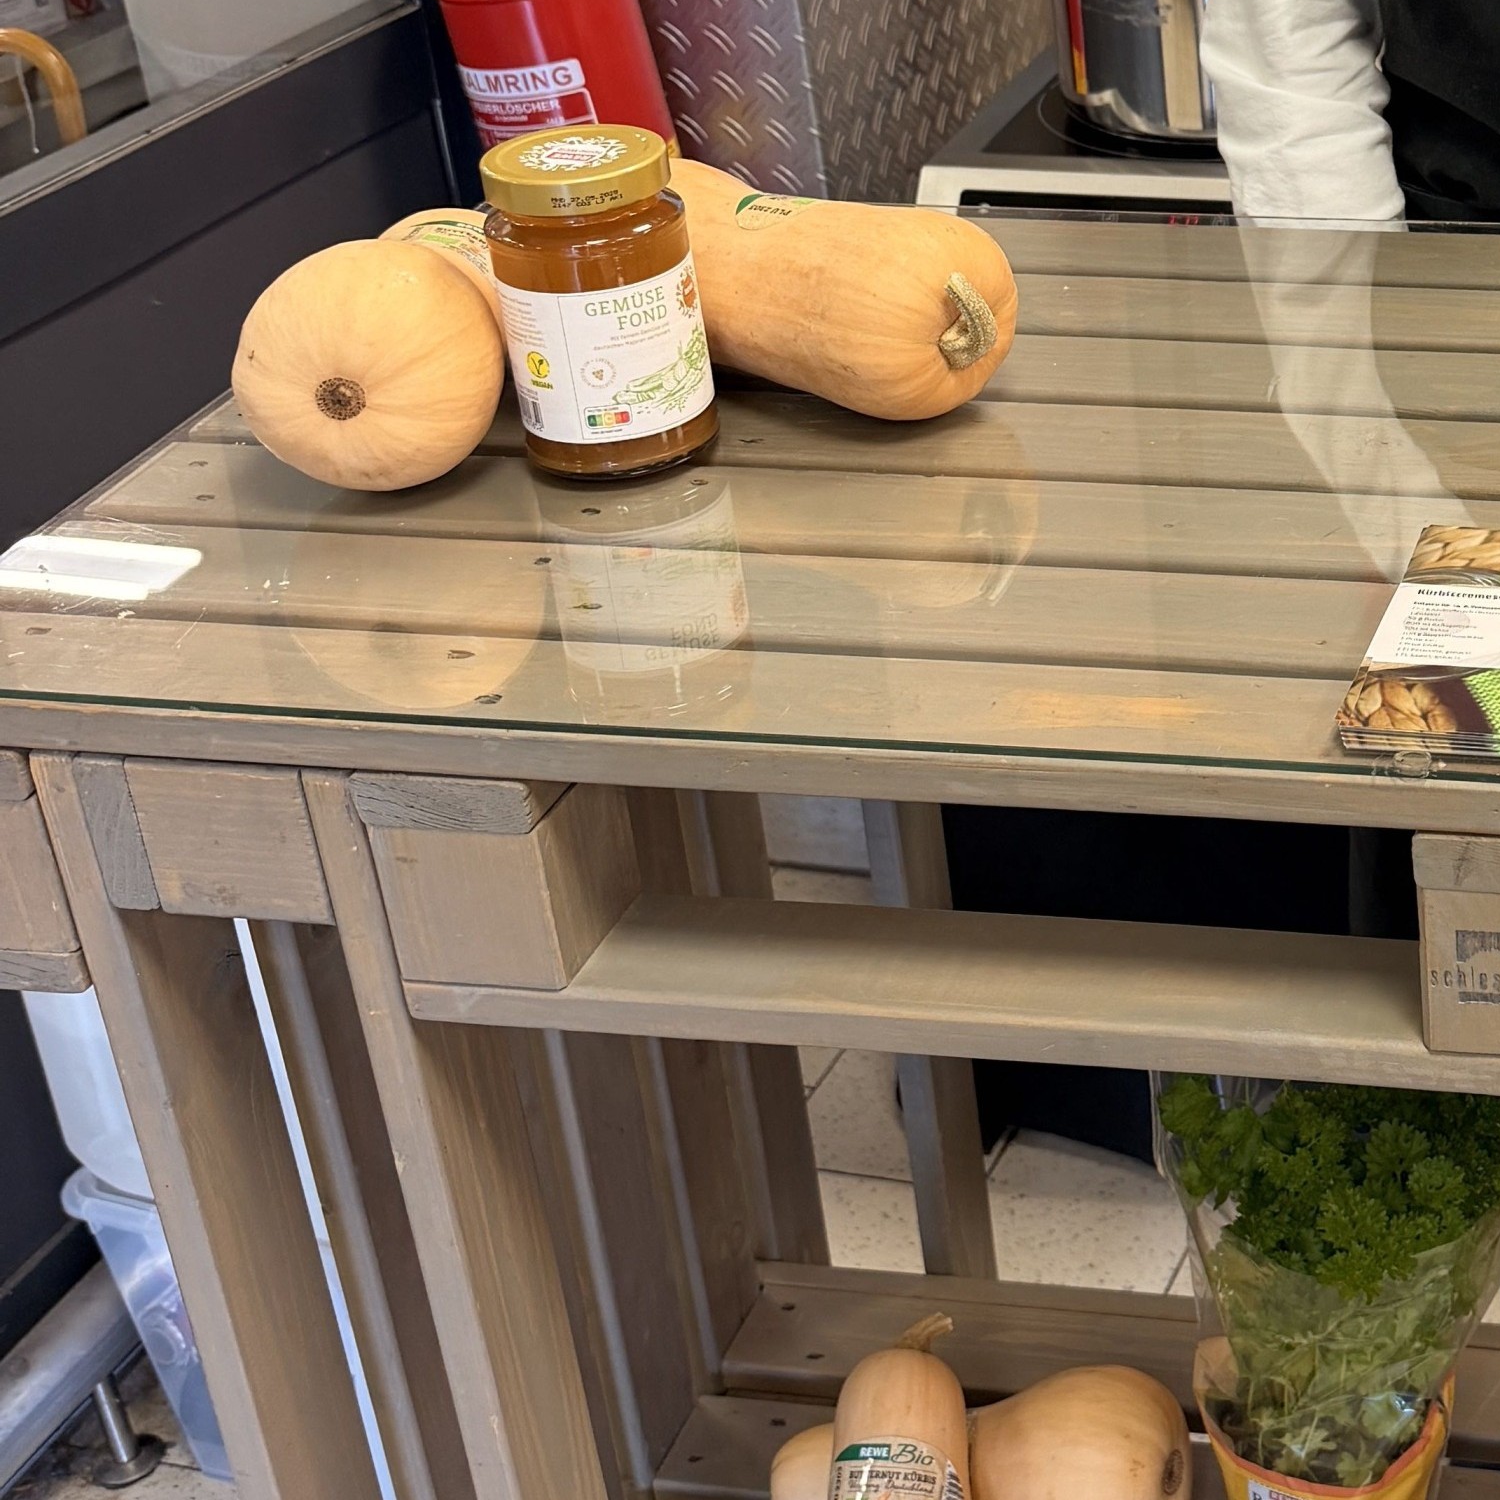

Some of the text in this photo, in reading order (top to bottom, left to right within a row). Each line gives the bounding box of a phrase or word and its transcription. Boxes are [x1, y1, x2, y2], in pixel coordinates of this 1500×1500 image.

[585, 286, 665, 317] GEMÜSE
[617, 304, 667, 331] FOND
[531, 379, 554, 390] VEGAN
[860, 1443, 935, 1466] REWE Bio
[849, 1469, 902, 1481] BUERNUT
